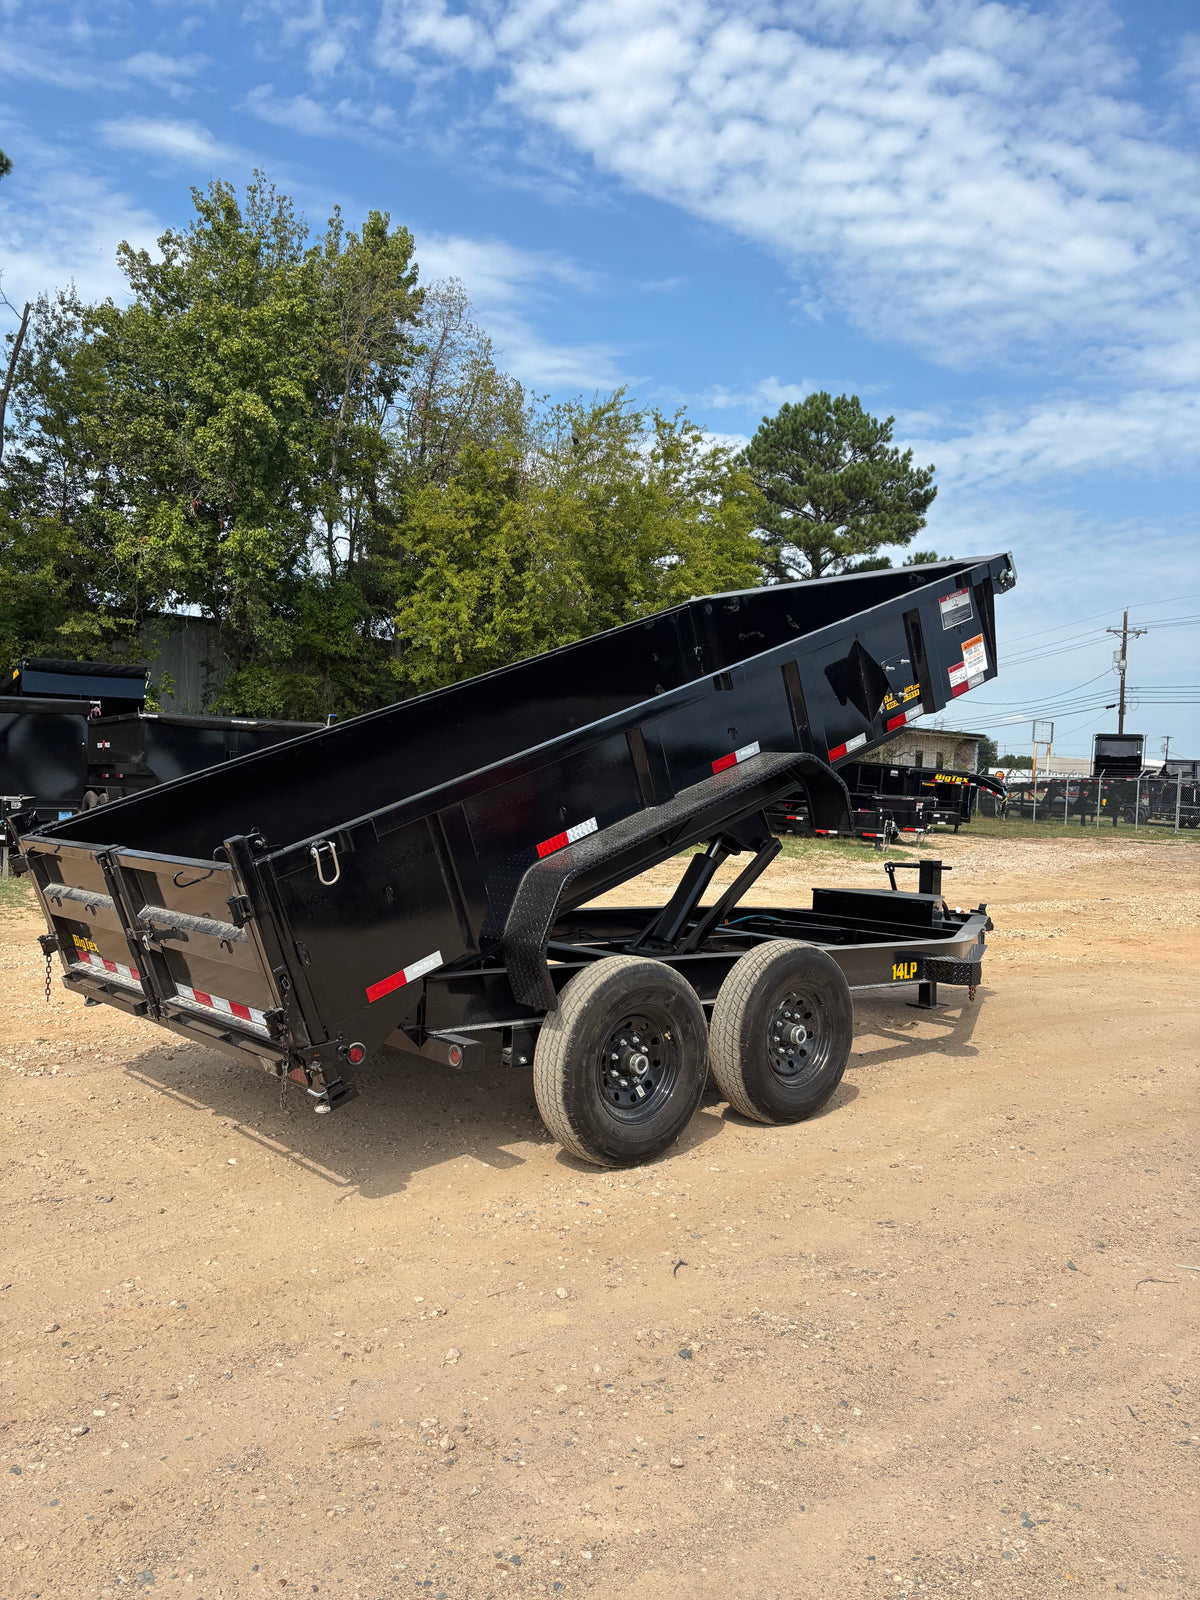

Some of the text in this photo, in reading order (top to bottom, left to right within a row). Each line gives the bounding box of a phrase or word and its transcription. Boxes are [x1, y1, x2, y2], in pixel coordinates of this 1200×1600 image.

[934, 773, 970, 783] BigTex
[72, 934, 99, 952] BigTex
[892, 961, 917, 980] 14LP
